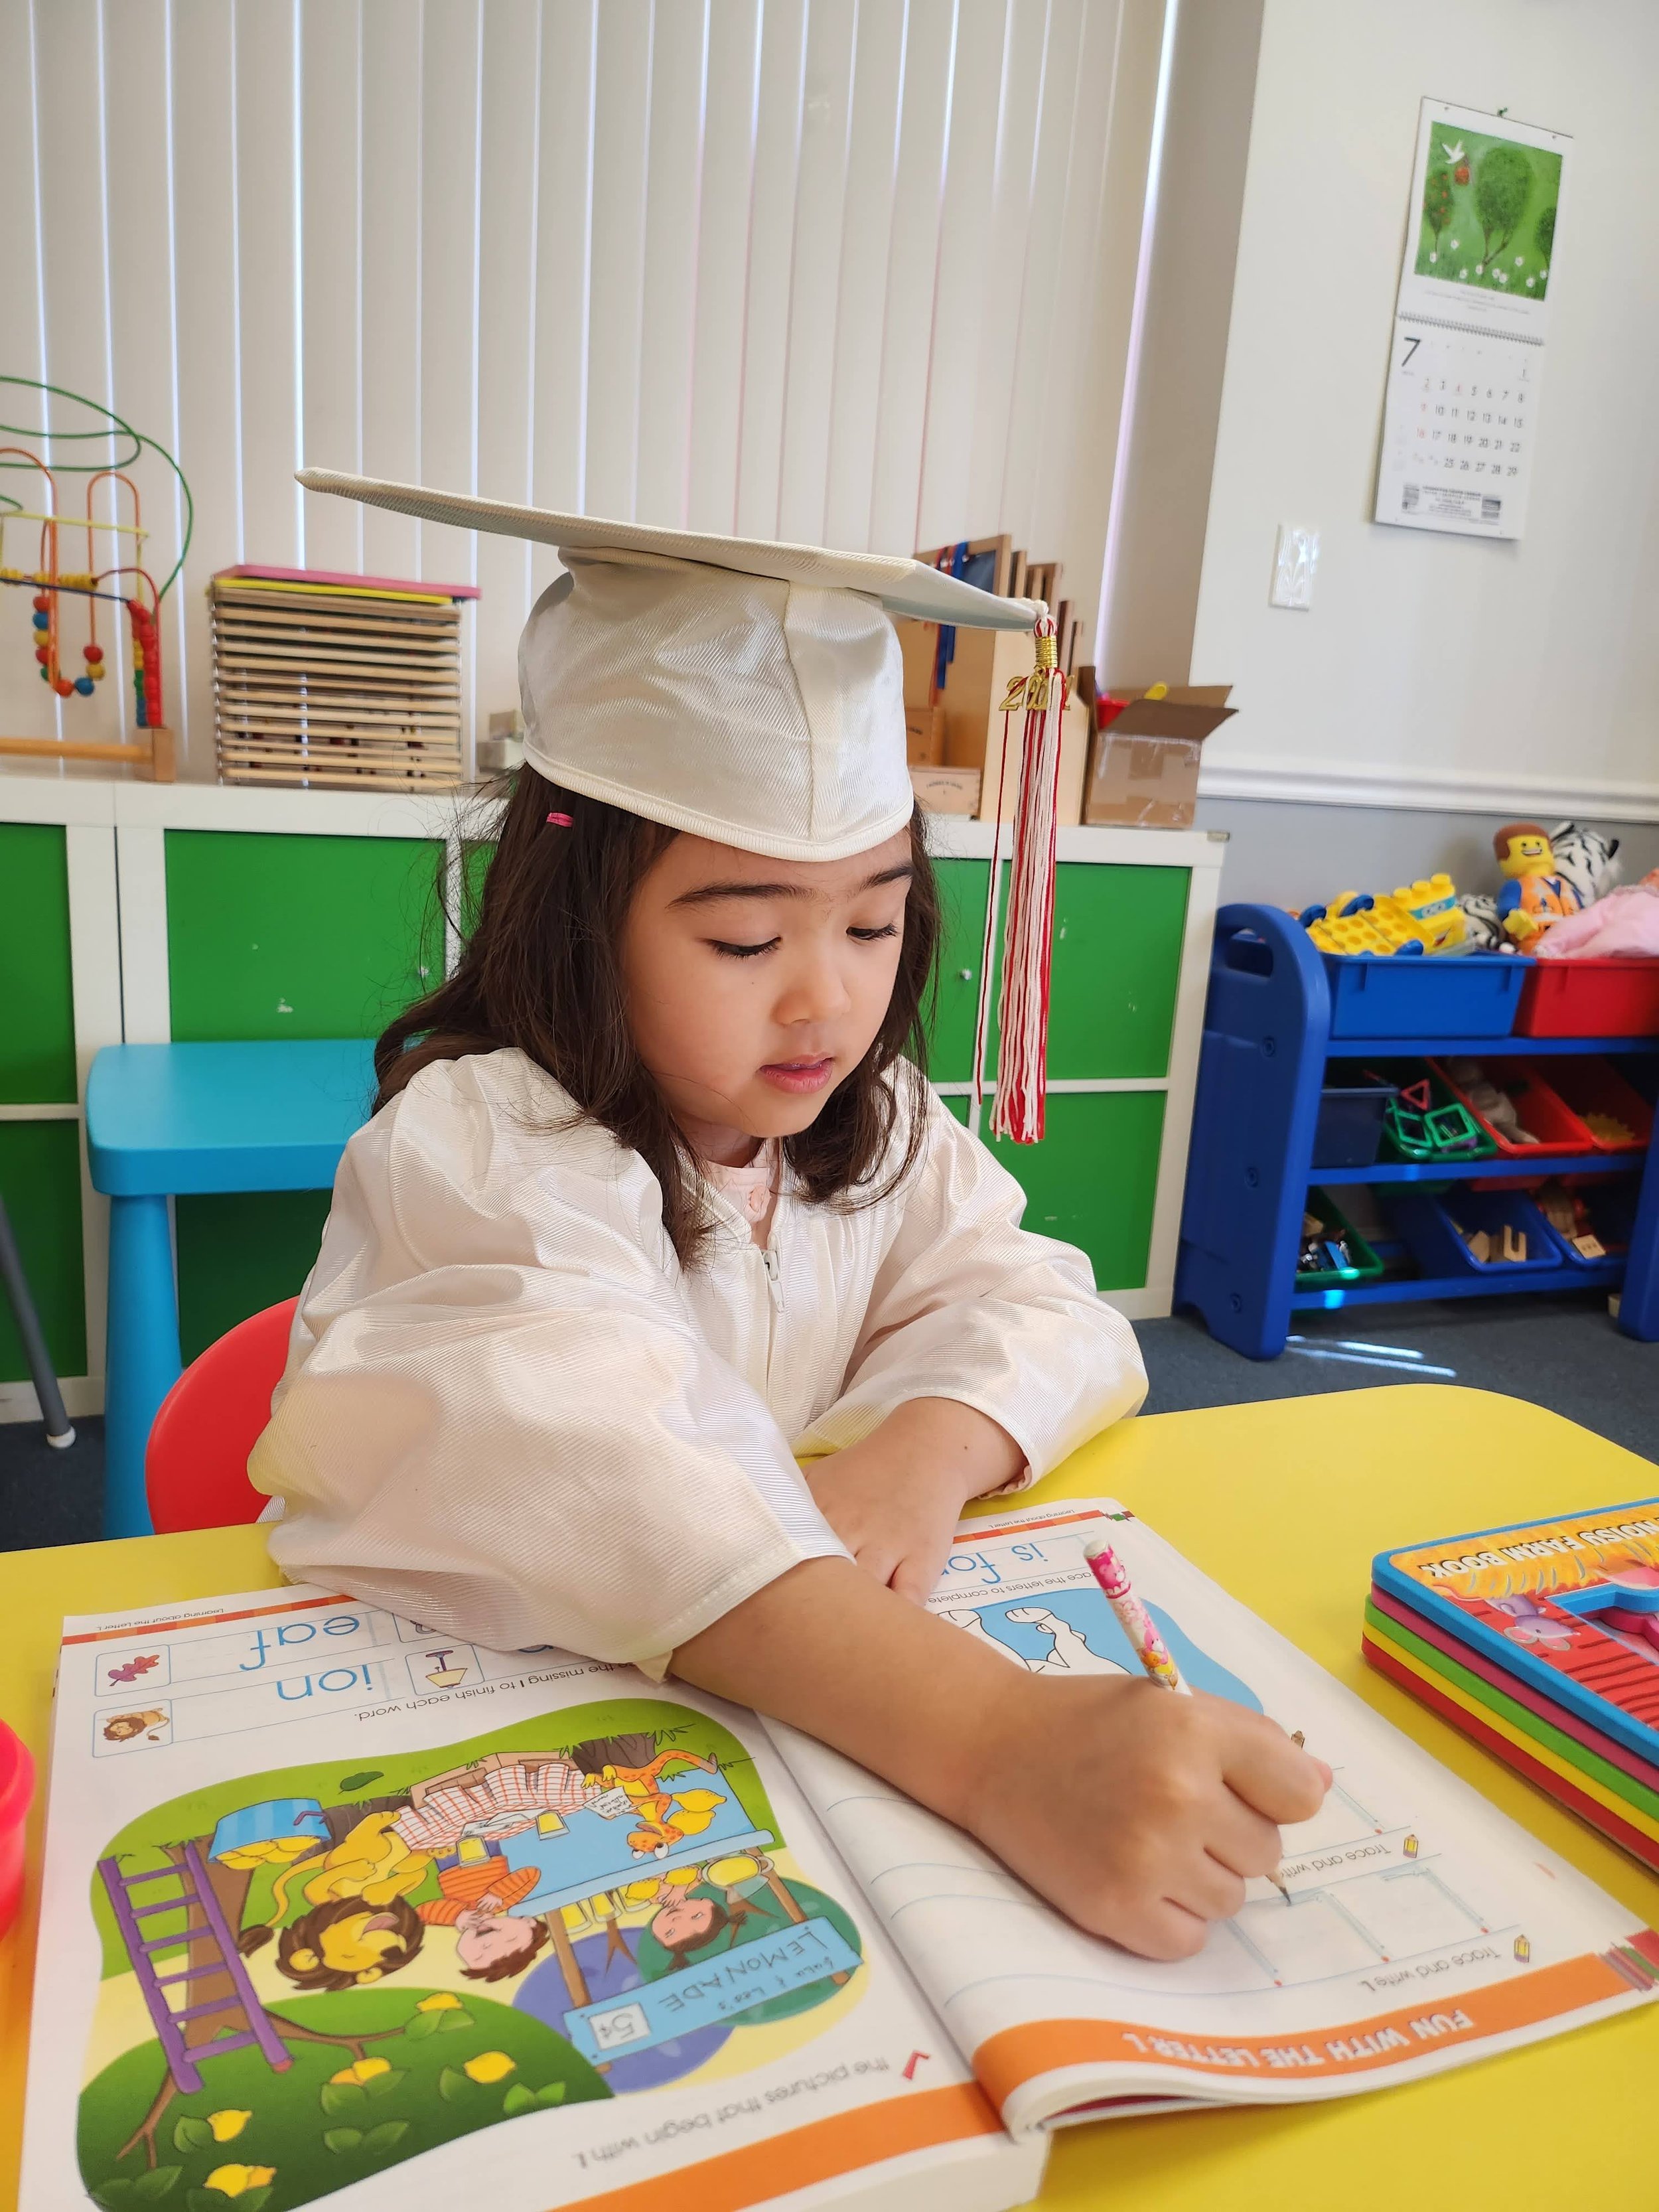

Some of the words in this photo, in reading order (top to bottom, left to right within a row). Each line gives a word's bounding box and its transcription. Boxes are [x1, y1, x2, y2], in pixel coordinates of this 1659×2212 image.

[1402, 336, 1421, 367] 7
[1451, 407, 1459, 417] 11
[1577, 1520, 1659, 1546] NOISY
[1011, 1542, 1048, 1562] is
[1499, 1536, 1586, 1562] FARM
[1416, 1551, 1508, 1579] BOOK
[1006, 1580, 1044, 1592] letters
[928, 1589, 988, 1604] complete
[152, 1614, 182, 1623] about
[184, 1608, 224, 1618] Learning
[104, 1622, 131, 1631] Letter
[499, 1680, 516, 1692] to
[529, 1668, 585, 1685] missing
[405, 1694, 451, 1710] each
[455, 1686, 496, 1700] finish
[354, 1705, 402, 1722] word.
[1344, 1843, 1393, 1861] Trace
[1311, 1855, 1344, 1872] and
[1451, 1946, 1502, 1967] Trace
[658, 1931, 829, 2013] LEMONADE
[1415, 1960, 1450, 1976] and
[1374, 1970, 1411, 1988] write
[1408, 2008, 1475, 2041] FUN
[1121, 2031, 1149, 2054] L
[1147, 2034, 1260, 2069] LETTER
[1325, 2026, 1411, 2063] WITH
[853, 2056, 890, 2075] the
[1260, 2043, 1327, 2069] THE
[763, 2062, 849, 2105] pictures
[716, 2096, 762, 2124] that
[643, 2112, 712, 2145] begin
[591, 2135, 640, 2162] with
